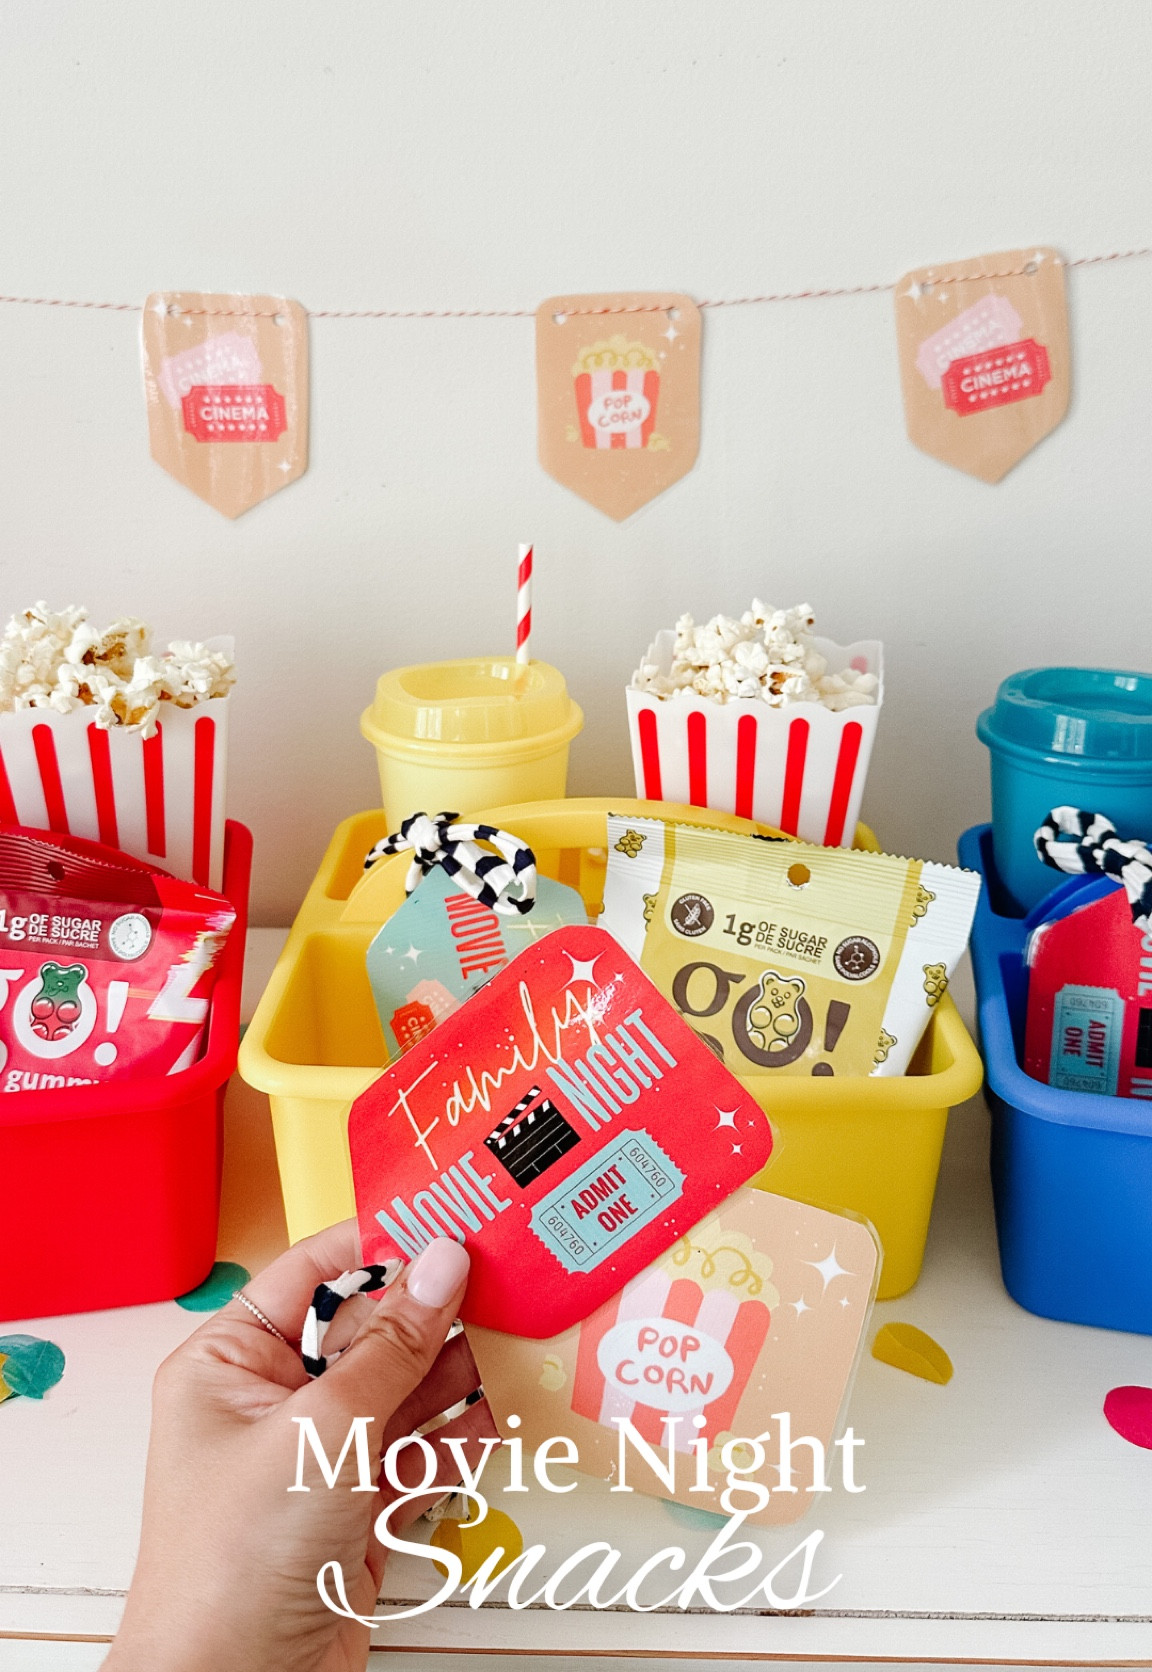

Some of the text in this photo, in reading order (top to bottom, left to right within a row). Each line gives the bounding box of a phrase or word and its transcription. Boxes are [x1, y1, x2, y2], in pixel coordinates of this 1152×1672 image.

[960, 362, 1032, 393] CINEMA
[199, 405, 270, 421] CINEMA
[597, 408, 642, 428] CORN
[602, 395, 632, 412] POP
[28, 924, 100, 942] DE SUCRE
[29, 913, 50, 925] OF
[51, 915, 102, 931] SUGAR
[444, 893, 510, 980] MOVIE
[722, 913, 828, 949] 1g OF SUGAR
[755, 932, 824, 958] DE SUCRE
[1063, 1026, 1084, 1057] ONE
[1085, 1019, 1107, 1068] ADMIT
[388, 981, 606, 1170] Family
[375, 1009, 678, 1260] MOVIE NIGHT
[629, 1147, 667, 1188] 604760
[570, 1163, 627, 1220] ADMIT
[597, 1193, 639, 1233] ONE
[547, 1215, 585, 1256] 604760
[637, 1326, 700, 1363] POP
[615, 1359, 714, 1395] CORN
